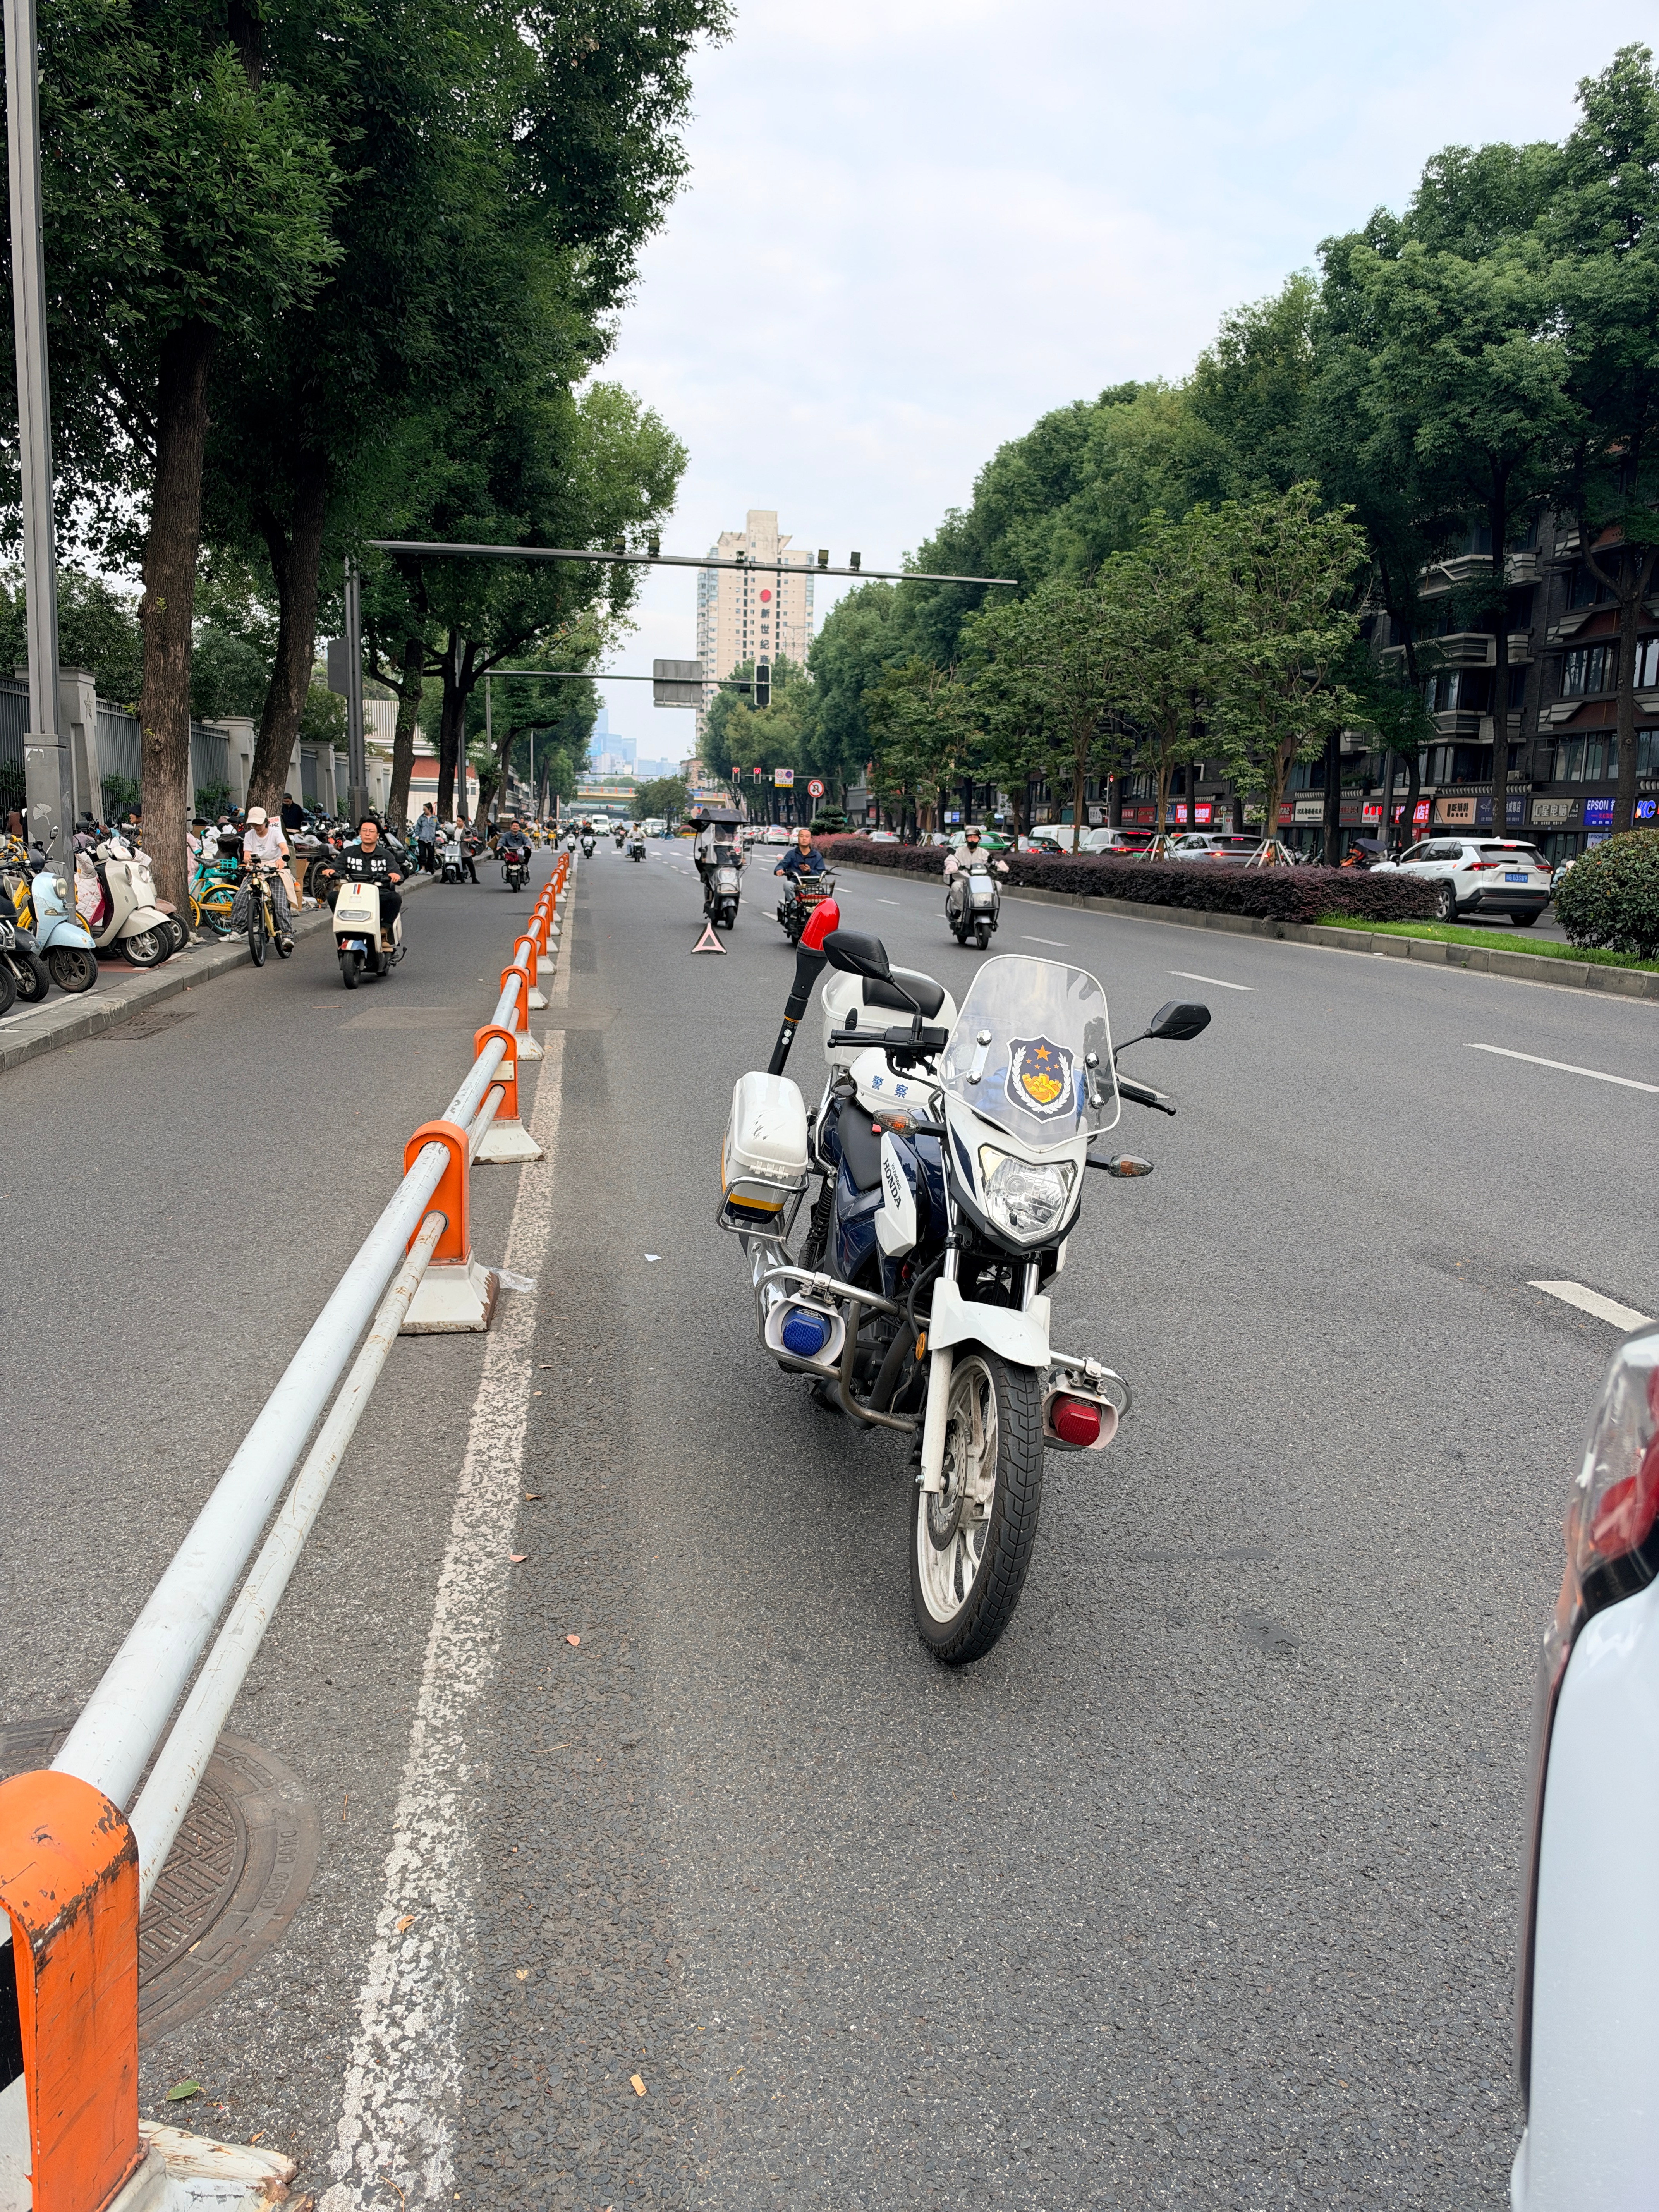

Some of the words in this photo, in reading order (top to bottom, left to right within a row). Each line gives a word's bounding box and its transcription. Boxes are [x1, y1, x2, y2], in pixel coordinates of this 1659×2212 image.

[760, 609, 770, 664] 新世纪商
[1535, 804, 1568, 817] 汇星电脑
[1587, 800, 1609, 810] EPSON
[871, 1075, 908, 1098] 警察
[883, 1158, 902, 1210] HONDA
[891, 1163, 902, 1190] WUYANG
